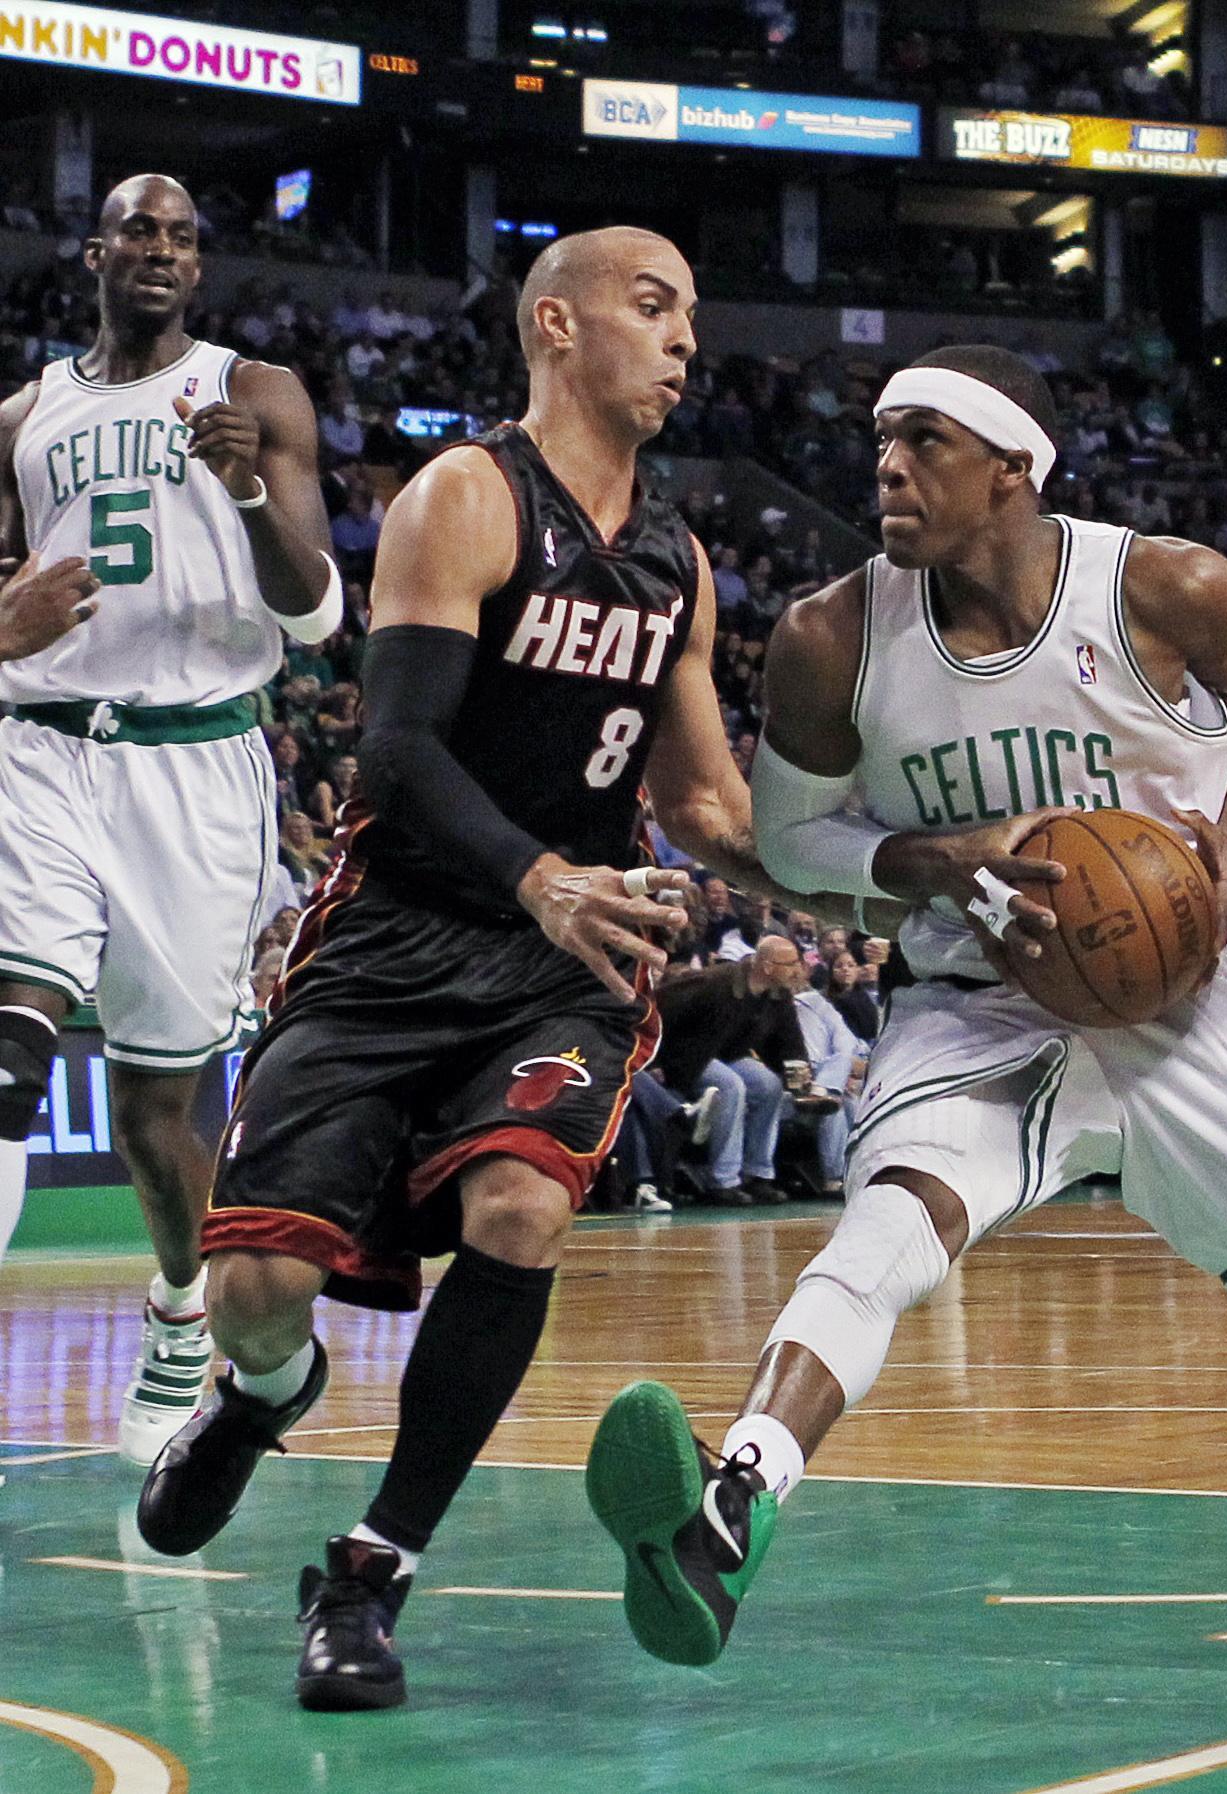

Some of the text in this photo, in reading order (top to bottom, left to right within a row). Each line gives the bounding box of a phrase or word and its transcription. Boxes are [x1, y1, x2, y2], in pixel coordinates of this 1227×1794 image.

[129, 30, 302, 90] DONUTS
[370, 54, 419, 76] CELTICS
[515, 74, 544, 94] HEAT
[603, 99, 652, 126] BCA
[682, 105, 756, 131] bizhub
[953, 119, 1072, 159] THE BUZZ
[1138, 127, 1190, 152] NESN
[46, 418, 190, 507] CELTICS
[89, 489, 154, 586] 5
[503, 594, 684, 686] HEAT
[584, 707, 644, 788] 8
[900, 725, 1122, 827] CELTICS
